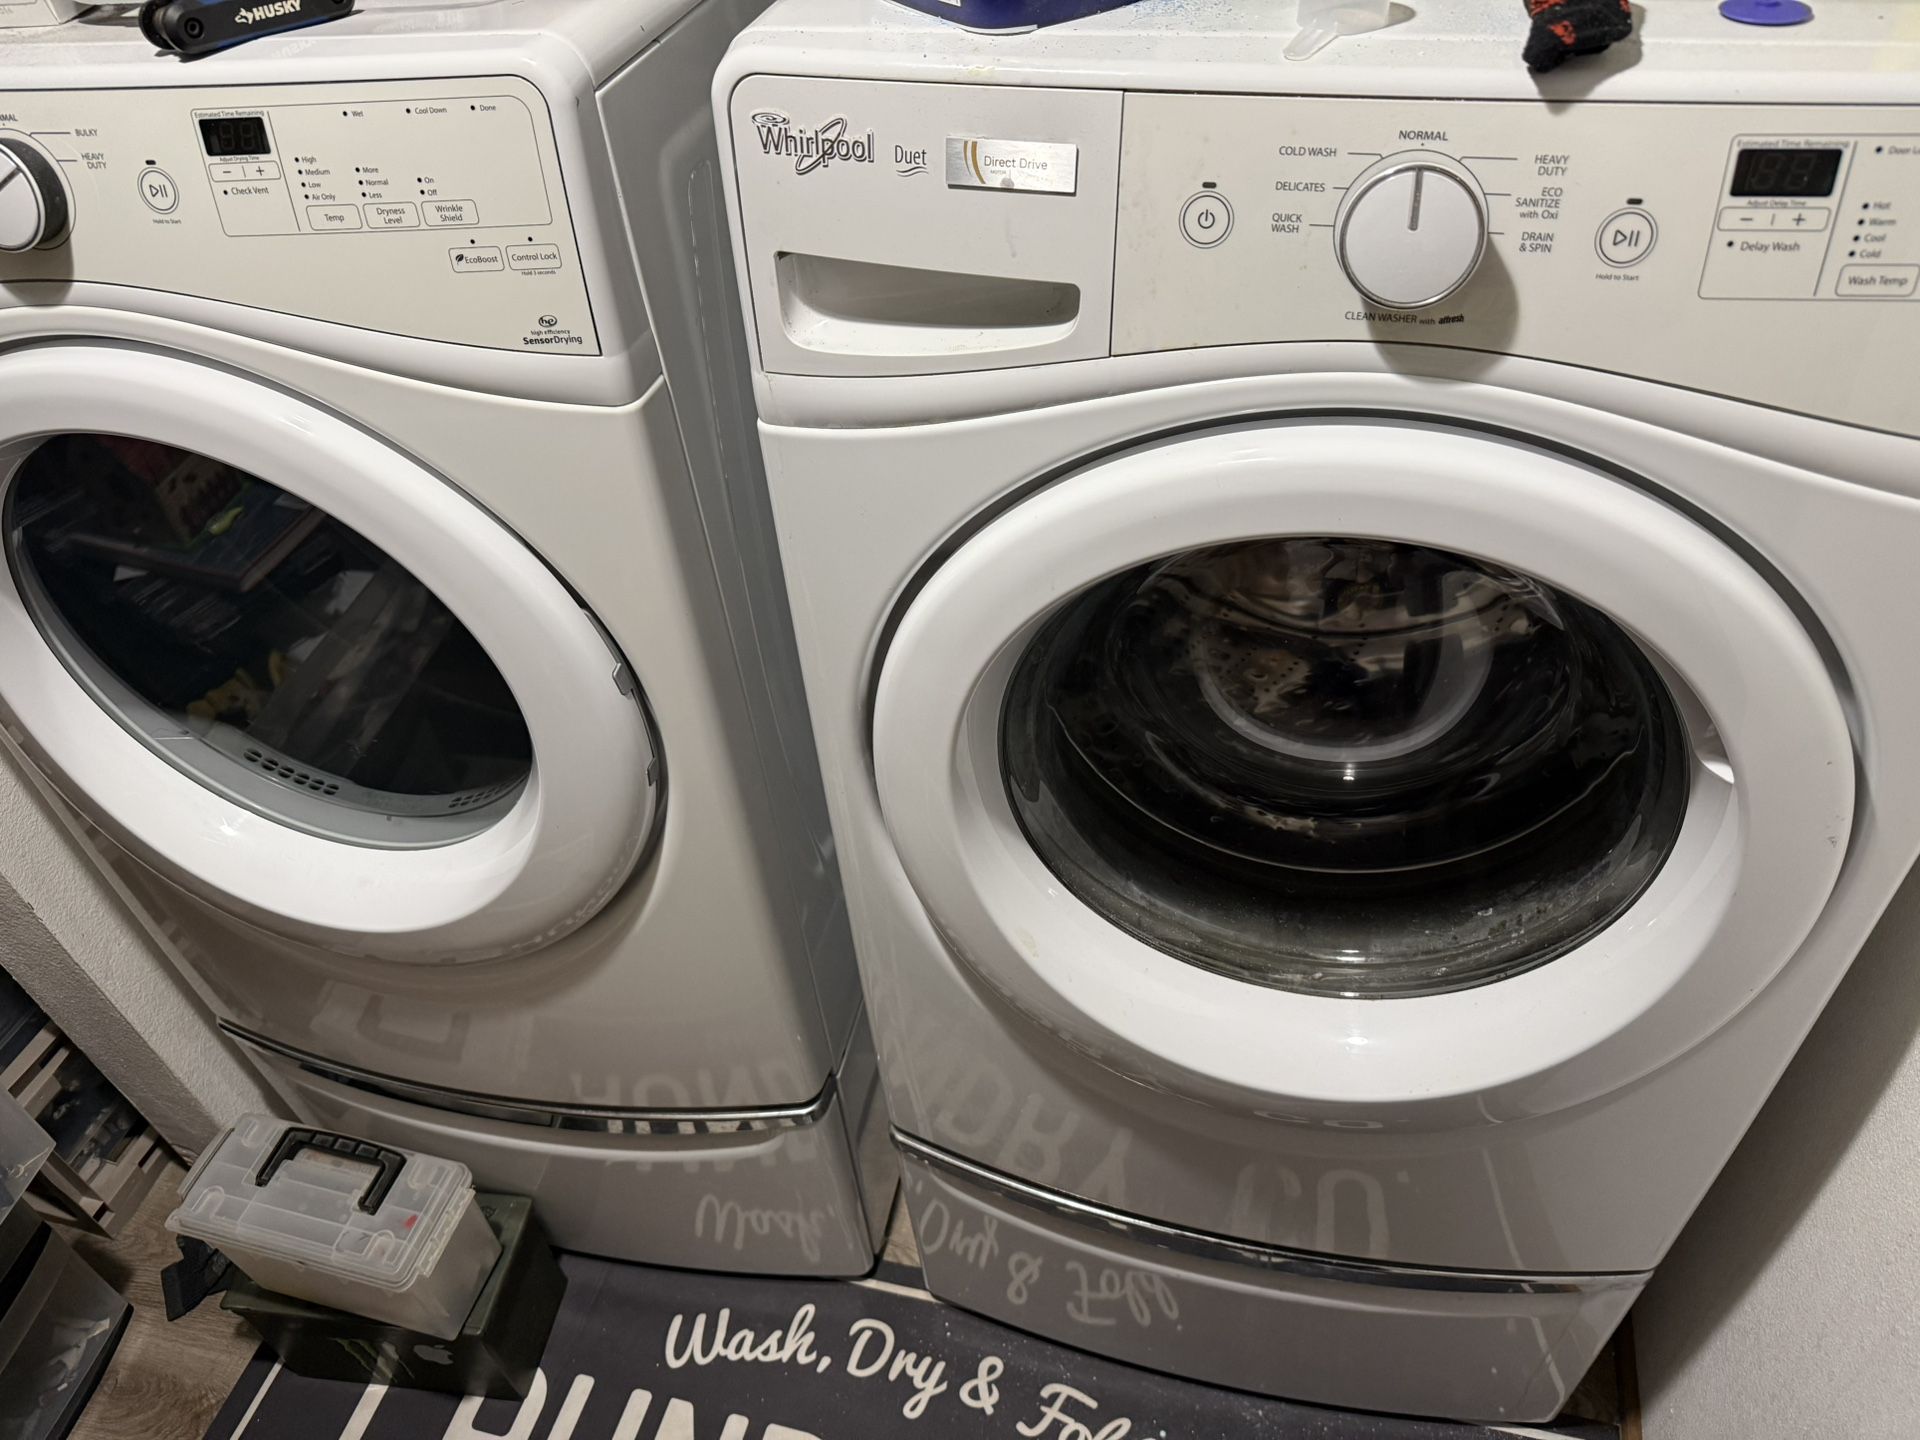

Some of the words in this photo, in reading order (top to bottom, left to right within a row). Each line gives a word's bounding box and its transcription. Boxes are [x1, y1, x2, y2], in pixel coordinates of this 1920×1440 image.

[253, 0, 301, 21] HUSKY
[235, 110, 264, 118] Remaining
[75, 129, 98, 137] BULKY
[1398, 130, 1449, 142] NORMAL
[753, 118, 875, 171] Whirlpool
[1738, 139, 1779, 148] Estimated
[1781, 139, 1801, 147] Time
[1804, 139, 1850, 149] Remaining
[894, 145, 927, 166] Duet
[1278, 146, 1307, 156] COLD
[1307, 147, 1337, 157] WASH
[81, 153, 104, 161] HEAVY
[302, 156, 316, 164] High
[1534, 154, 1570, 165] HEAVY
[984, 155, 1017, 169] Direct
[1019, 157, 1048, 170] Drive
[1537, 166, 1568, 176] DUTY
[231, 187, 250, 196] Check
[252, 186, 269, 195] Vent
[1275, 181, 1326, 193] DELICATES
[321, 193, 336, 202] Only
[1541, 187, 1563, 198] ECO
[435, 204, 463, 213] Wrinkle
[1515, 198, 1561, 209] SANITIZE
[1770, 200, 1789, 208] Delay
[1873, 202, 1891, 210] Hot
[376, 207, 405, 217] Dryness
[1519, 210, 1539, 219] with
[1541, 209, 1559, 220] Oxi
[324, 214, 345, 223] Temp
[384, 216, 403, 224] Level
[440, 214, 463, 222] Shield
[1272, 213, 1303, 224] QUICK
[1868, 218, 1896, 226] Warm
[1271, 223, 1300, 234] WASH
[1521, 231, 1555, 242] DRAIN
[1863, 234, 1887, 243] Cool
[1519, 242, 1527, 252] &
[1528, 242, 1552, 253] SPIN
[1740, 241, 1770, 253] Delay
[1772, 242, 1800, 251] Wash
[465, 255, 498, 264] EcoBoost
[511, 254, 539, 262] Control
[540, 252, 558, 260] Lock
[1859, 250, 1882, 259] Cold
[1595, 273, 1612, 281] Hold
[1613, 273, 1621, 281] to
[1622, 273, 1640, 281] Start
[1847, 276, 1877, 286] Wash
[1878, 276, 1908, 288] Temp
[1344, 311, 1376, 322] CLEAN
[1377, 313, 1418, 324] WASHER
[1419, 317, 1436, 326] with
[523, 335, 583, 345] SensorDrying
[664, 1303, 833, 1375] Wash,
[846, 1317, 949, 1420] Dry
[959, 1355, 1004, 1416] &
